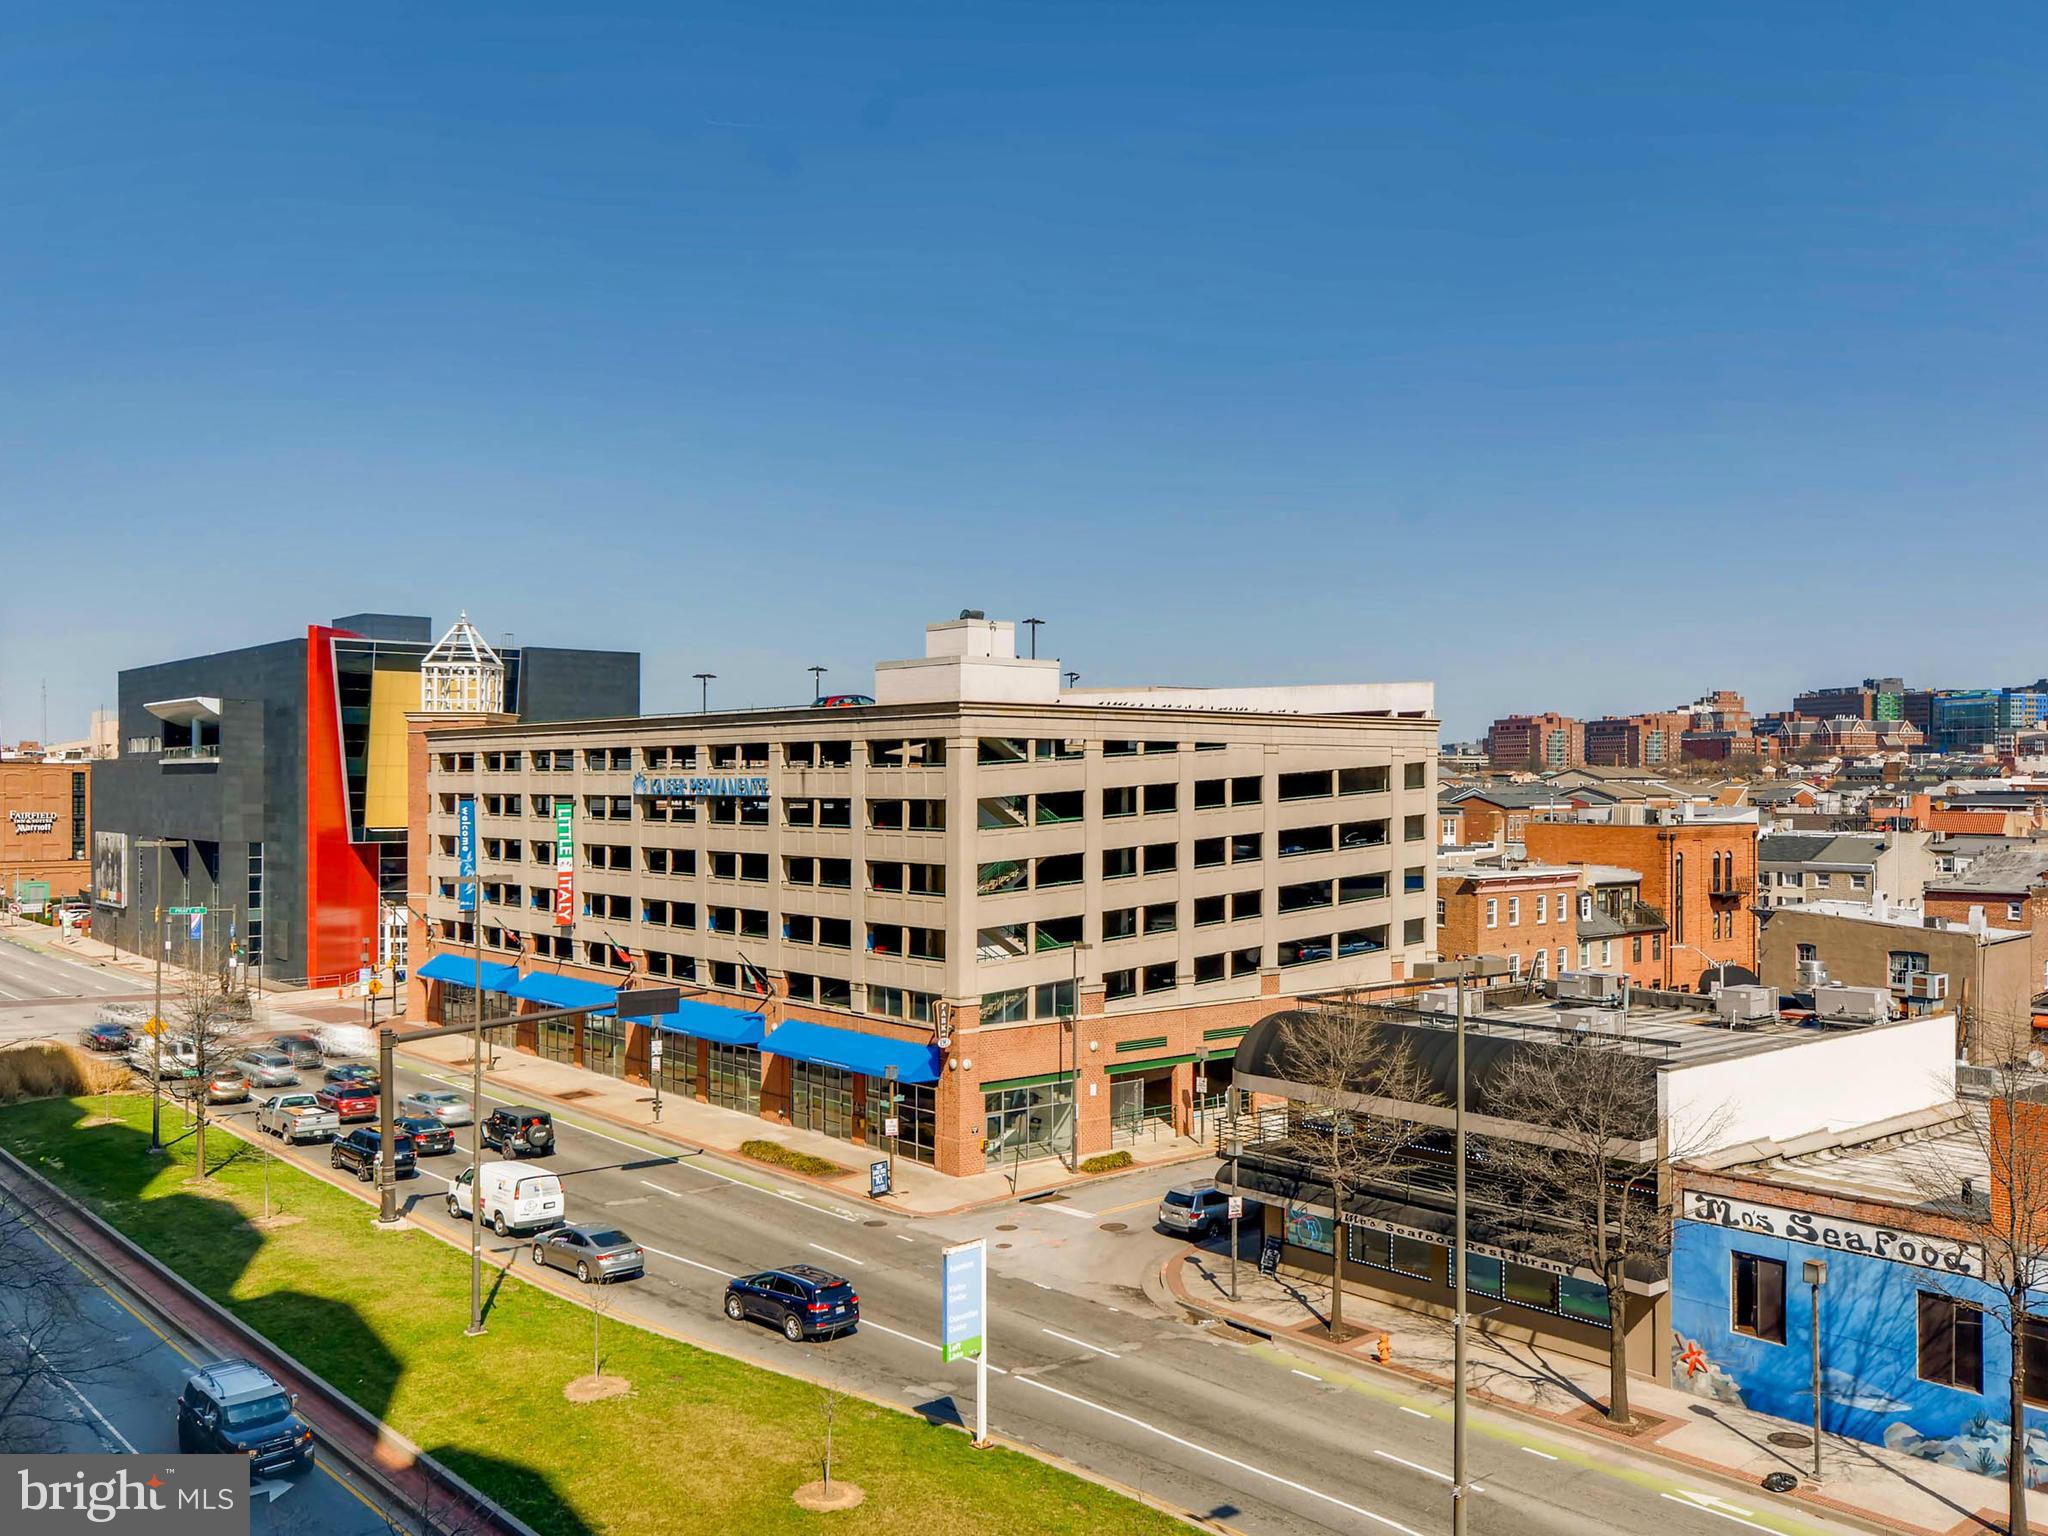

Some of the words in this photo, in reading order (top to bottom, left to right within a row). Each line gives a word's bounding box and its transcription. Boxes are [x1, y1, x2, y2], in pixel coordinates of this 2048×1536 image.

[650, 778, 688, 796] KAISER
[689, 778, 769, 796] PERMANENTE
[10, 810, 57, 820] FAIRFIELD
[462, 806, 471, 852] welcome
[557, 808, 572, 856] LITTLE
[557, 876, 573, 920] ITALY
[1695, 1192, 1775, 1233] Mo's
[1344, 1213, 1376, 1229] Mo's
[1384, 1223, 1457, 1247] Seafood
[1465, 1242, 1574, 1275] Restaurant
